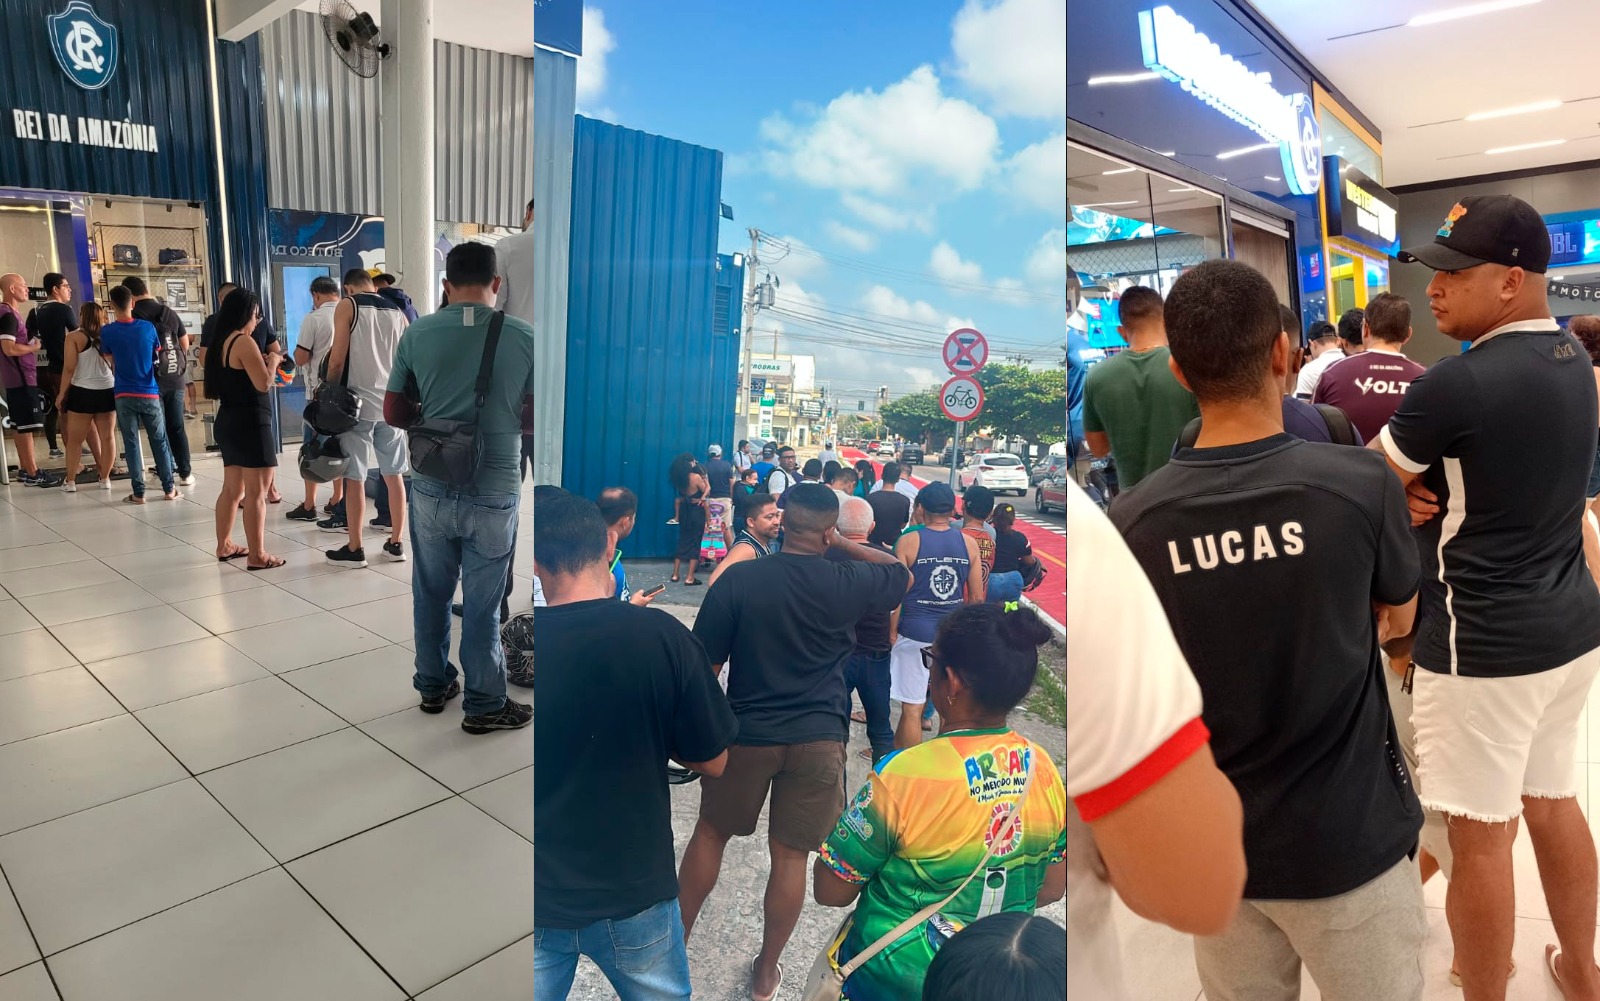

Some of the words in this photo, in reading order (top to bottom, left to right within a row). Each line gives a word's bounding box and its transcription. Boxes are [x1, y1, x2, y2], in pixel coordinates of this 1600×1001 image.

[13, 109, 43, 140] REI
[48, 113, 72, 143] DA
[78, 117, 158, 152] AMAZÔNIA
[740, 363, 780, 371] PROBRAS
[1354, 377, 1411, 395] VOLT
[1168, 521, 1304, 574] LUCAS
[970, 786, 981, 796] NO
[1013, 777, 1026, 786] MU
